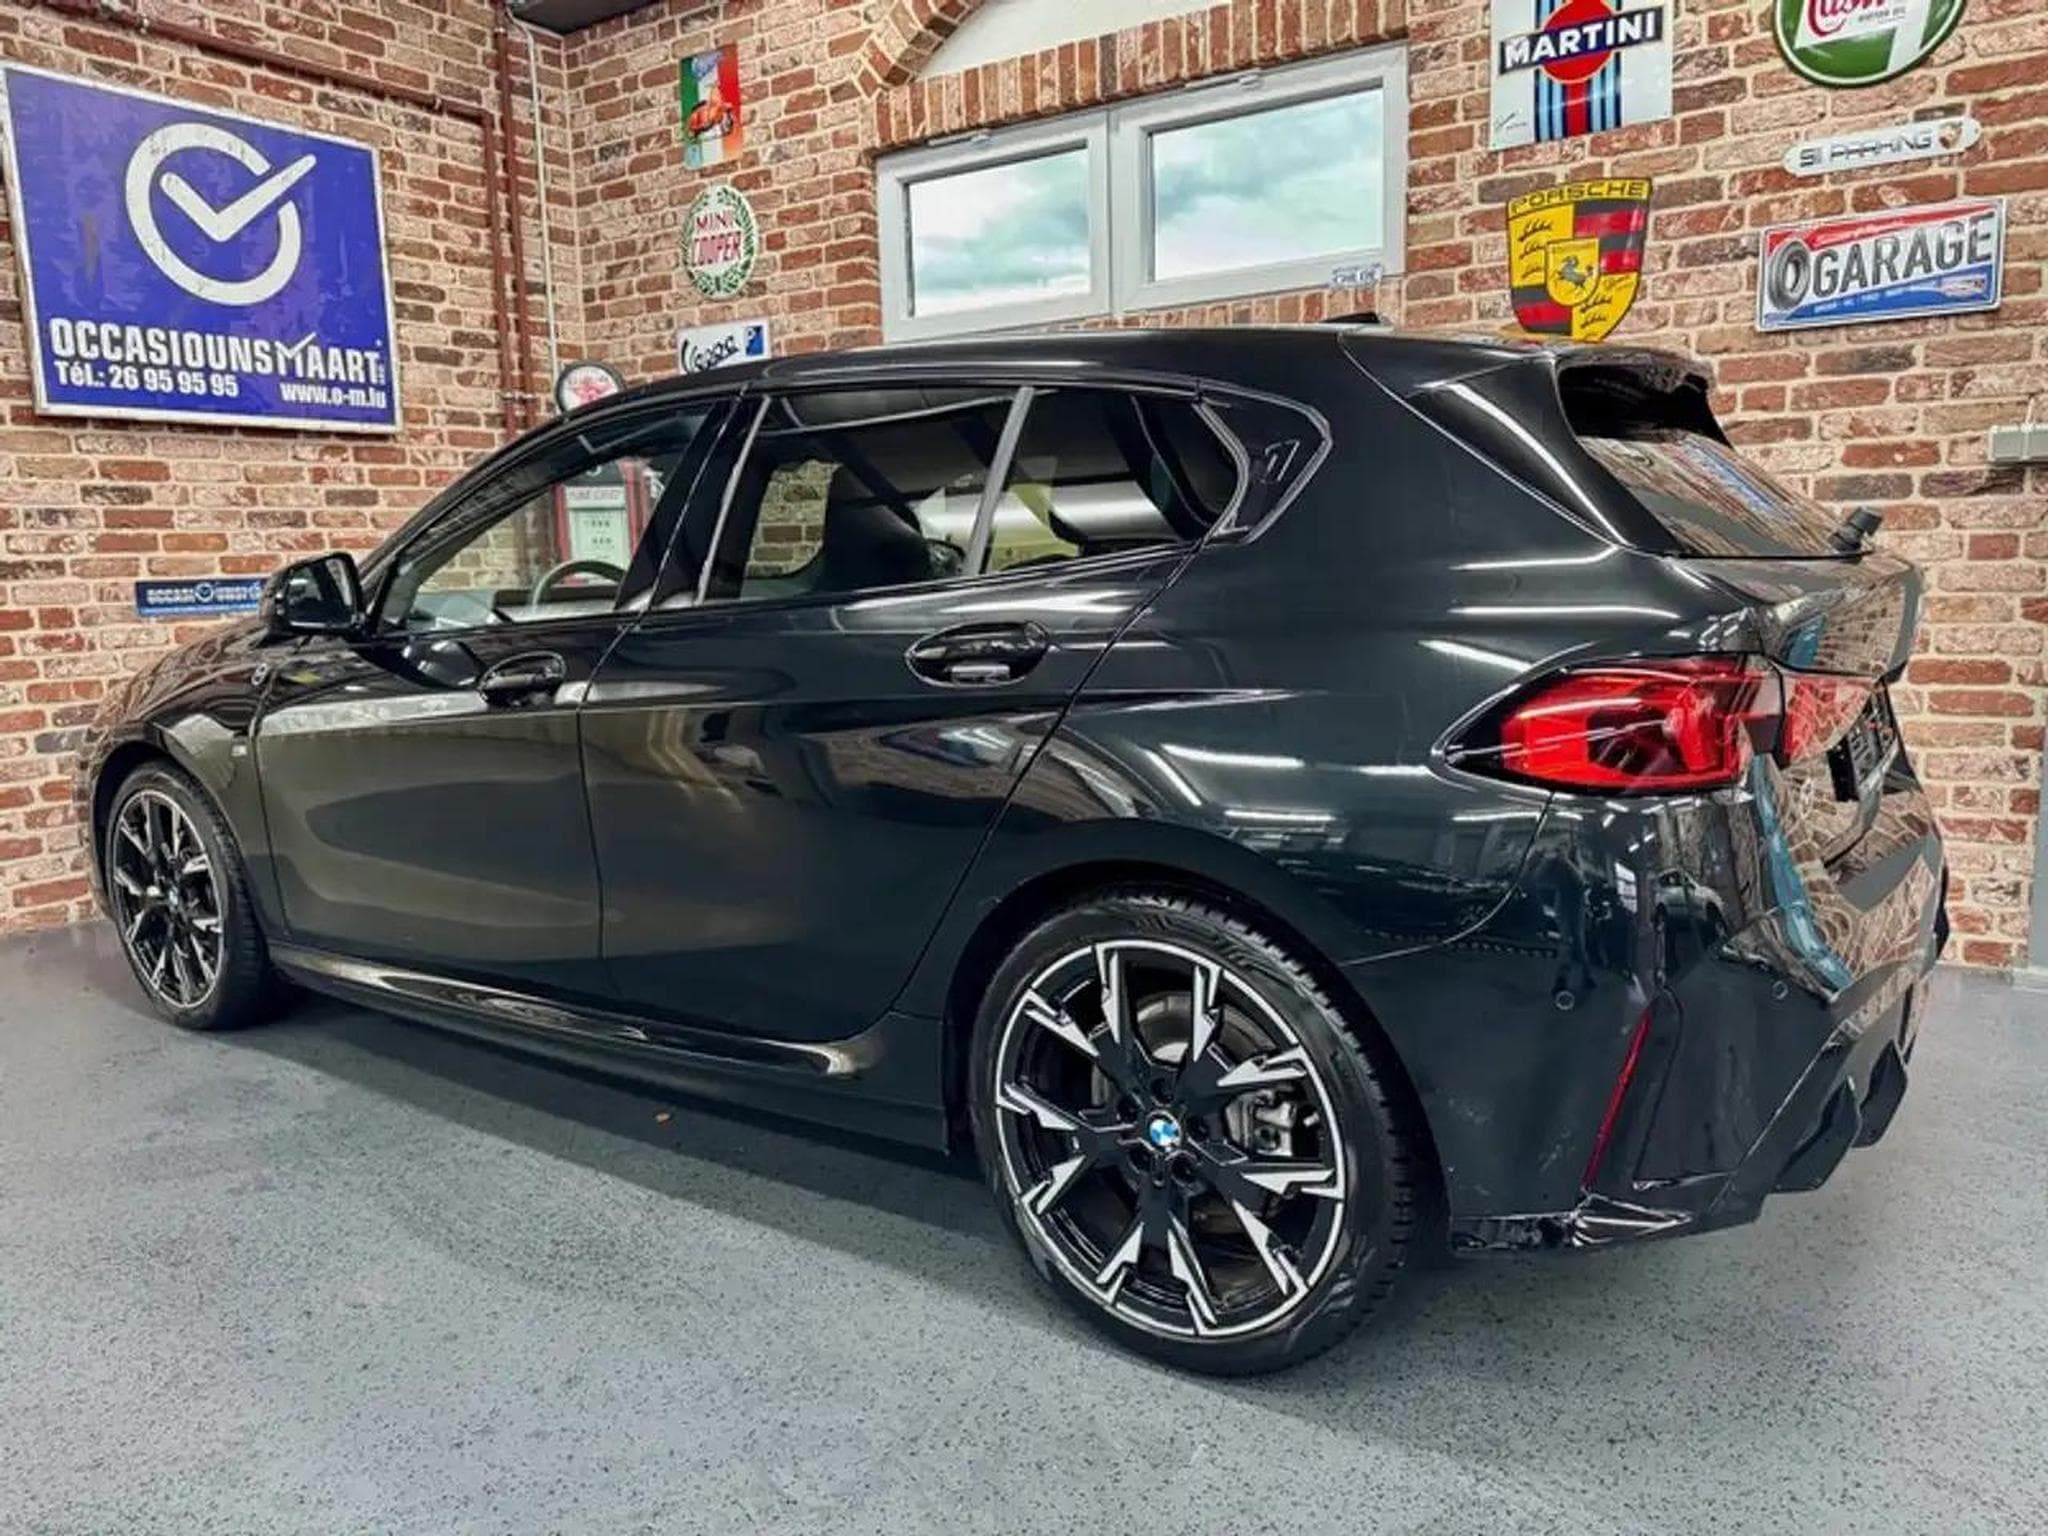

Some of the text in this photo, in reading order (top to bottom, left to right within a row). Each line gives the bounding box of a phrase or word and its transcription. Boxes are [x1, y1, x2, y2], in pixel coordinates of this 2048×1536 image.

[1505, 12, 1656, 68] MARTINI
[1511, 181, 1645, 214] PORSCHE
[1812, 211, 1995, 298] GARAGE
[49, 317, 381, 385] OCCASIOUNSMAART
[108, 365, 139, 391] 26
[143, 368, 174, 393] 95
[177, 371, 207, 396] 95
[210, 374, 240, 398] 95
[279, 382, 388, 409] www.o-m.lu
